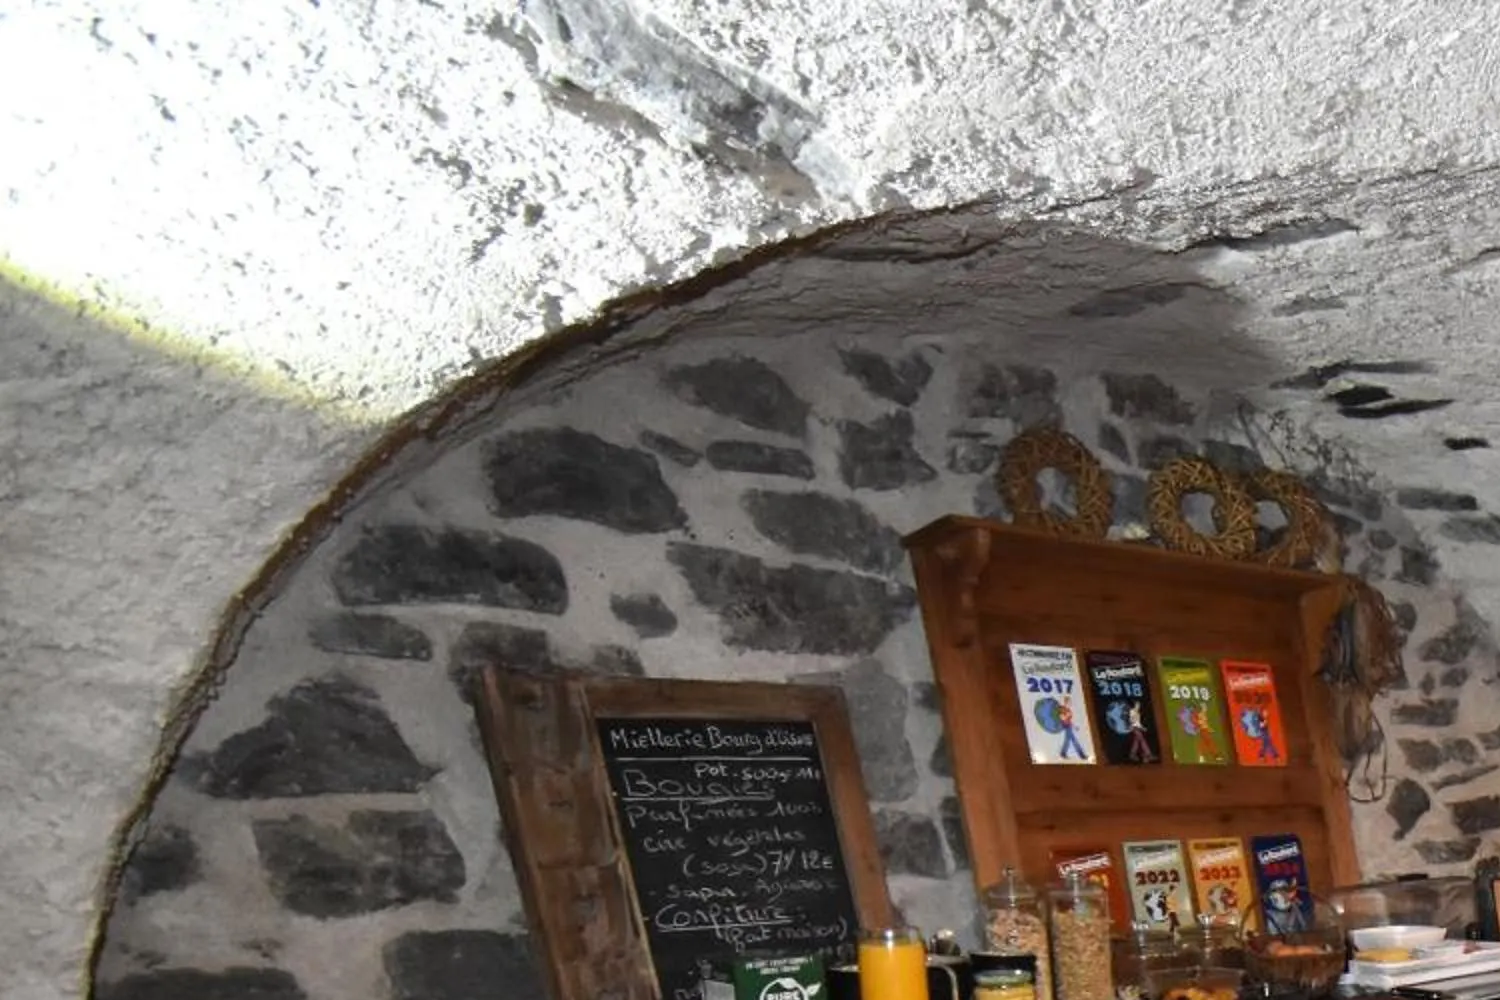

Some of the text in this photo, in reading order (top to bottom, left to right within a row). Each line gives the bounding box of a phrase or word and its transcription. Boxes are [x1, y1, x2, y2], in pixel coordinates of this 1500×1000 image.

[1026, 677, 1073, 694] 2017
[1098, 680, 1143, 697] 2018
[1135, 869, 1179, 886] 2022
